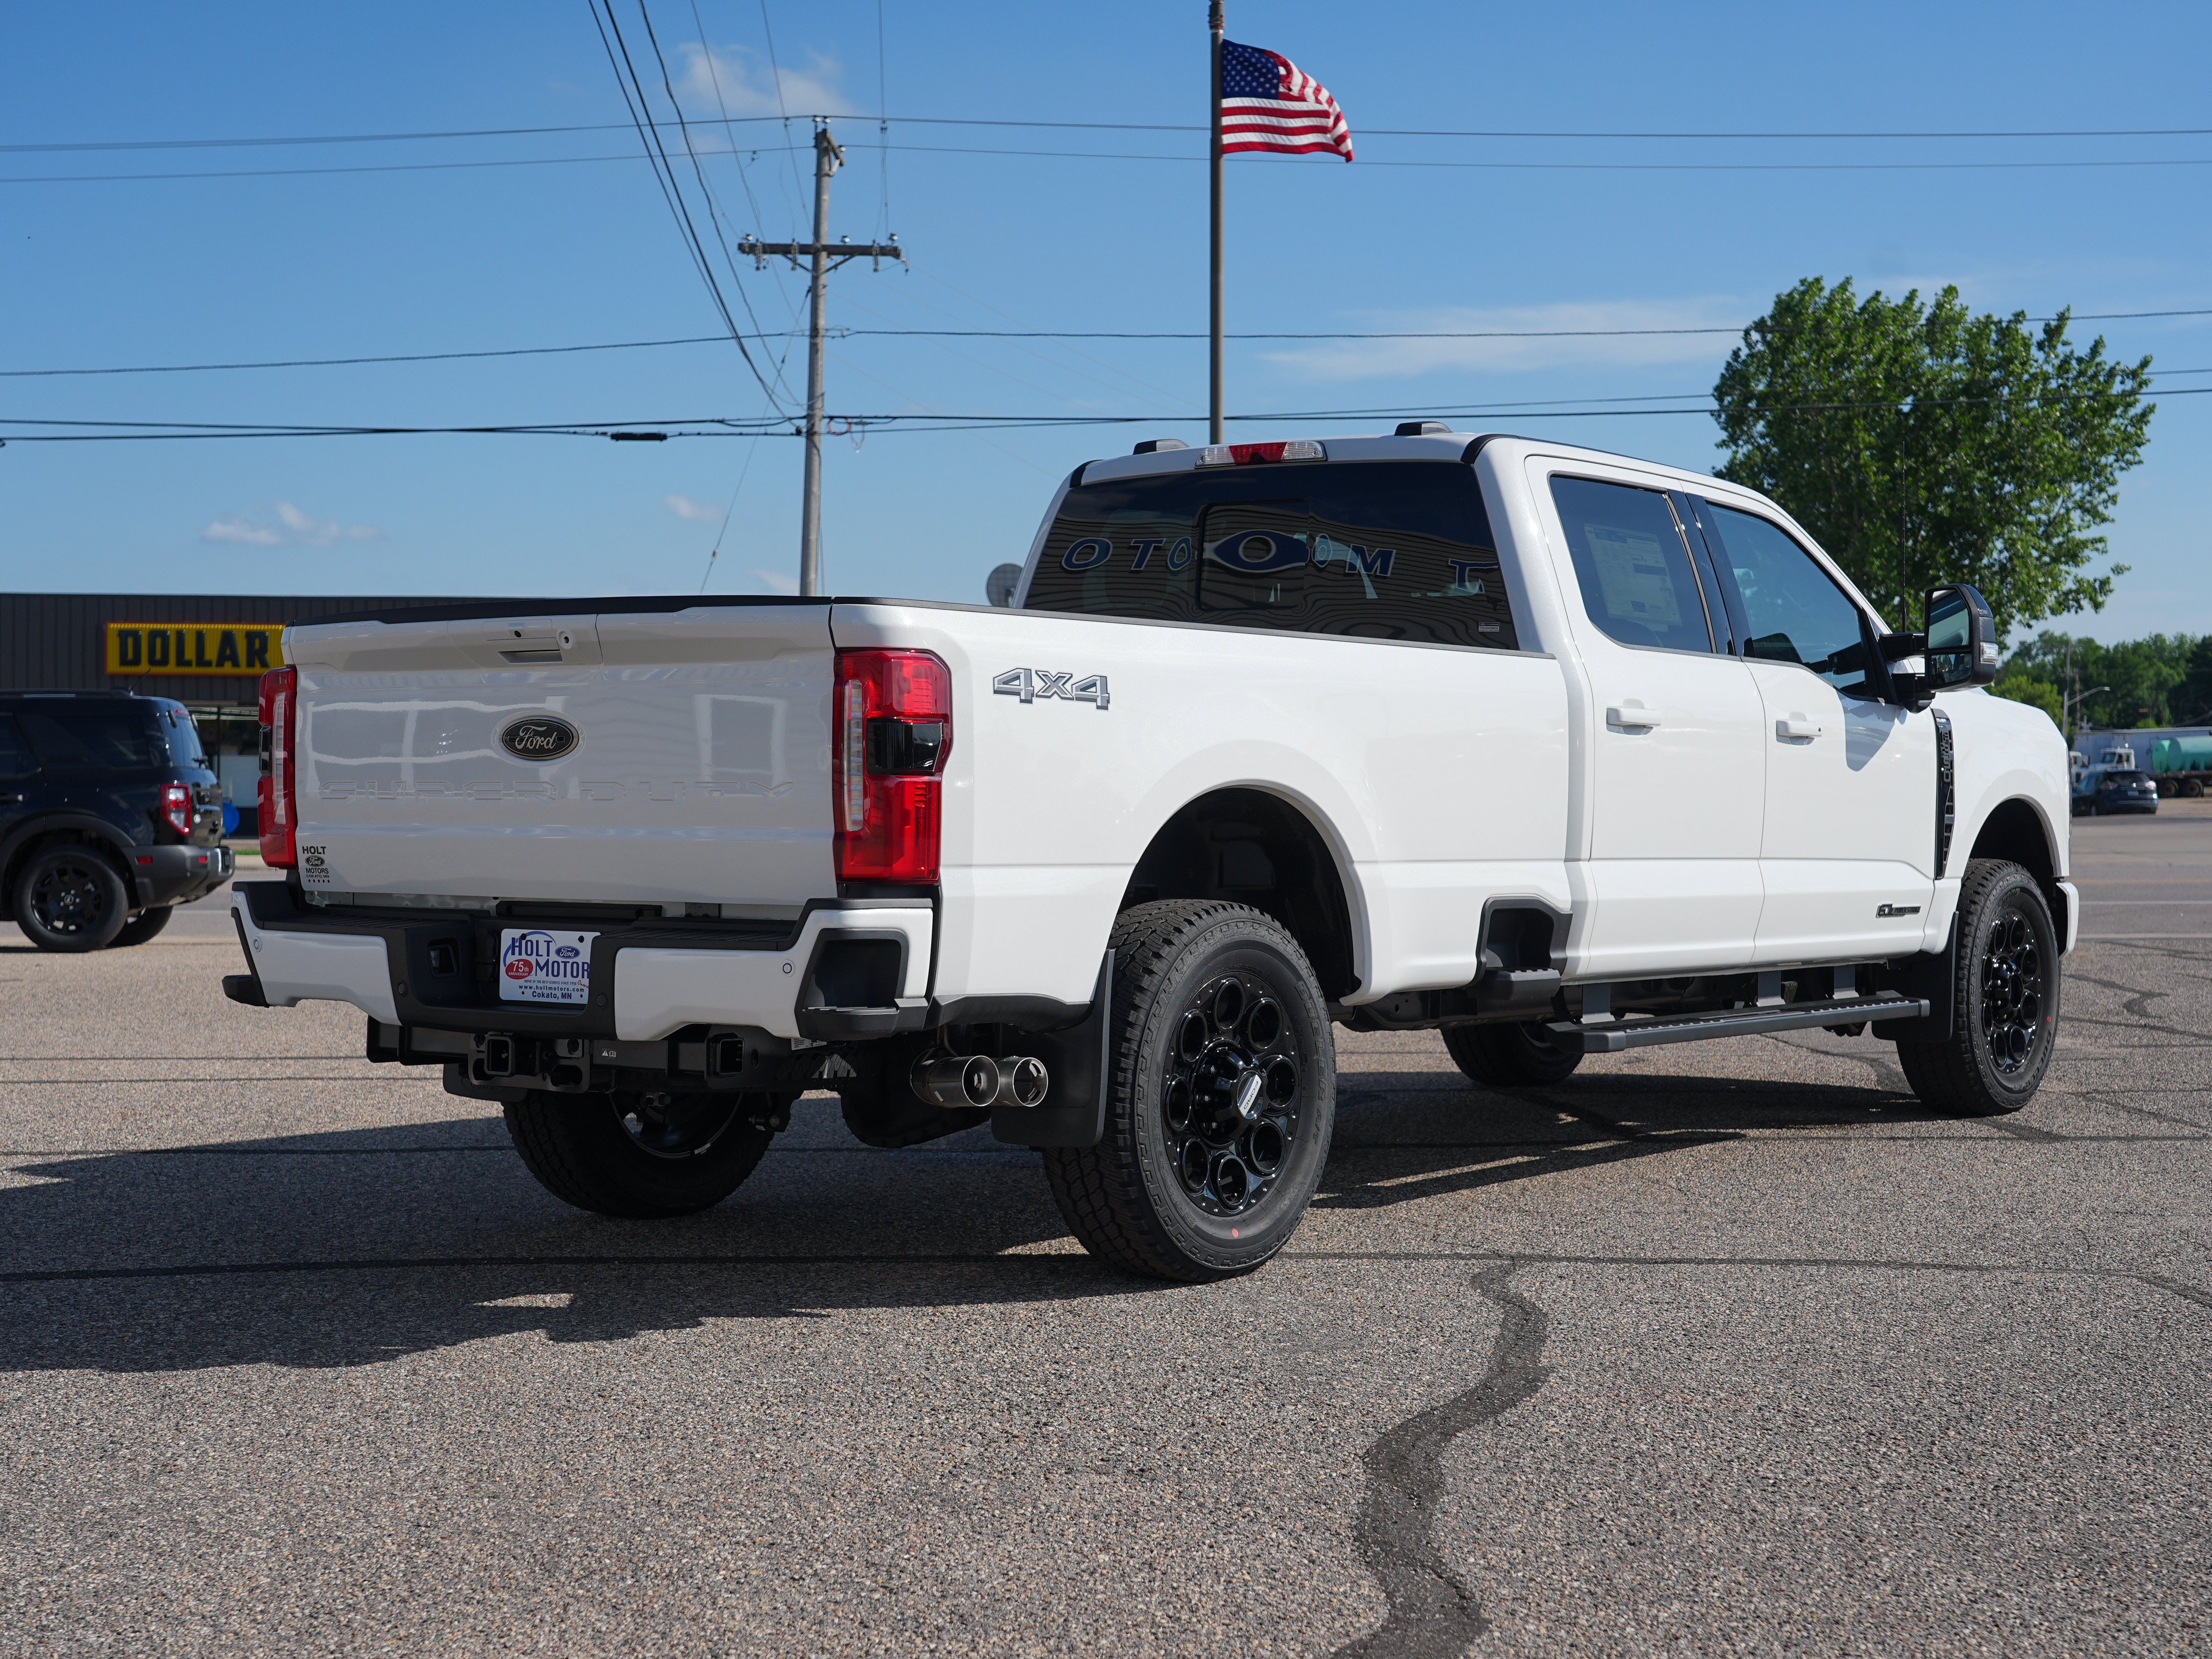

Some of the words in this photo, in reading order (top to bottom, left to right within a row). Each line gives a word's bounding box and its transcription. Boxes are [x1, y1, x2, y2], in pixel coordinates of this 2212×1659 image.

[118, 630, 271, 667] DOLLAR
[515, 725, 557, 750] Ford
[321, 780, 558, 804] SUPER
[581, 781, 794, 806] DUTY
[302, 846, 326, 855] HOLT
[309, 857, 321, 865] Ford
[511, 937, 553, 957] HOLT
[559, 947, 576, 957] Ford
[512, 961, 529, 973] 75th
[518, 984, 584, 993] www.holtmotors.com
[532, 990, 559, 1000] Cokato,
[1294, 980, 1326, 1102] DUELER
[1244, 1081, 1259, 1109] FORD
